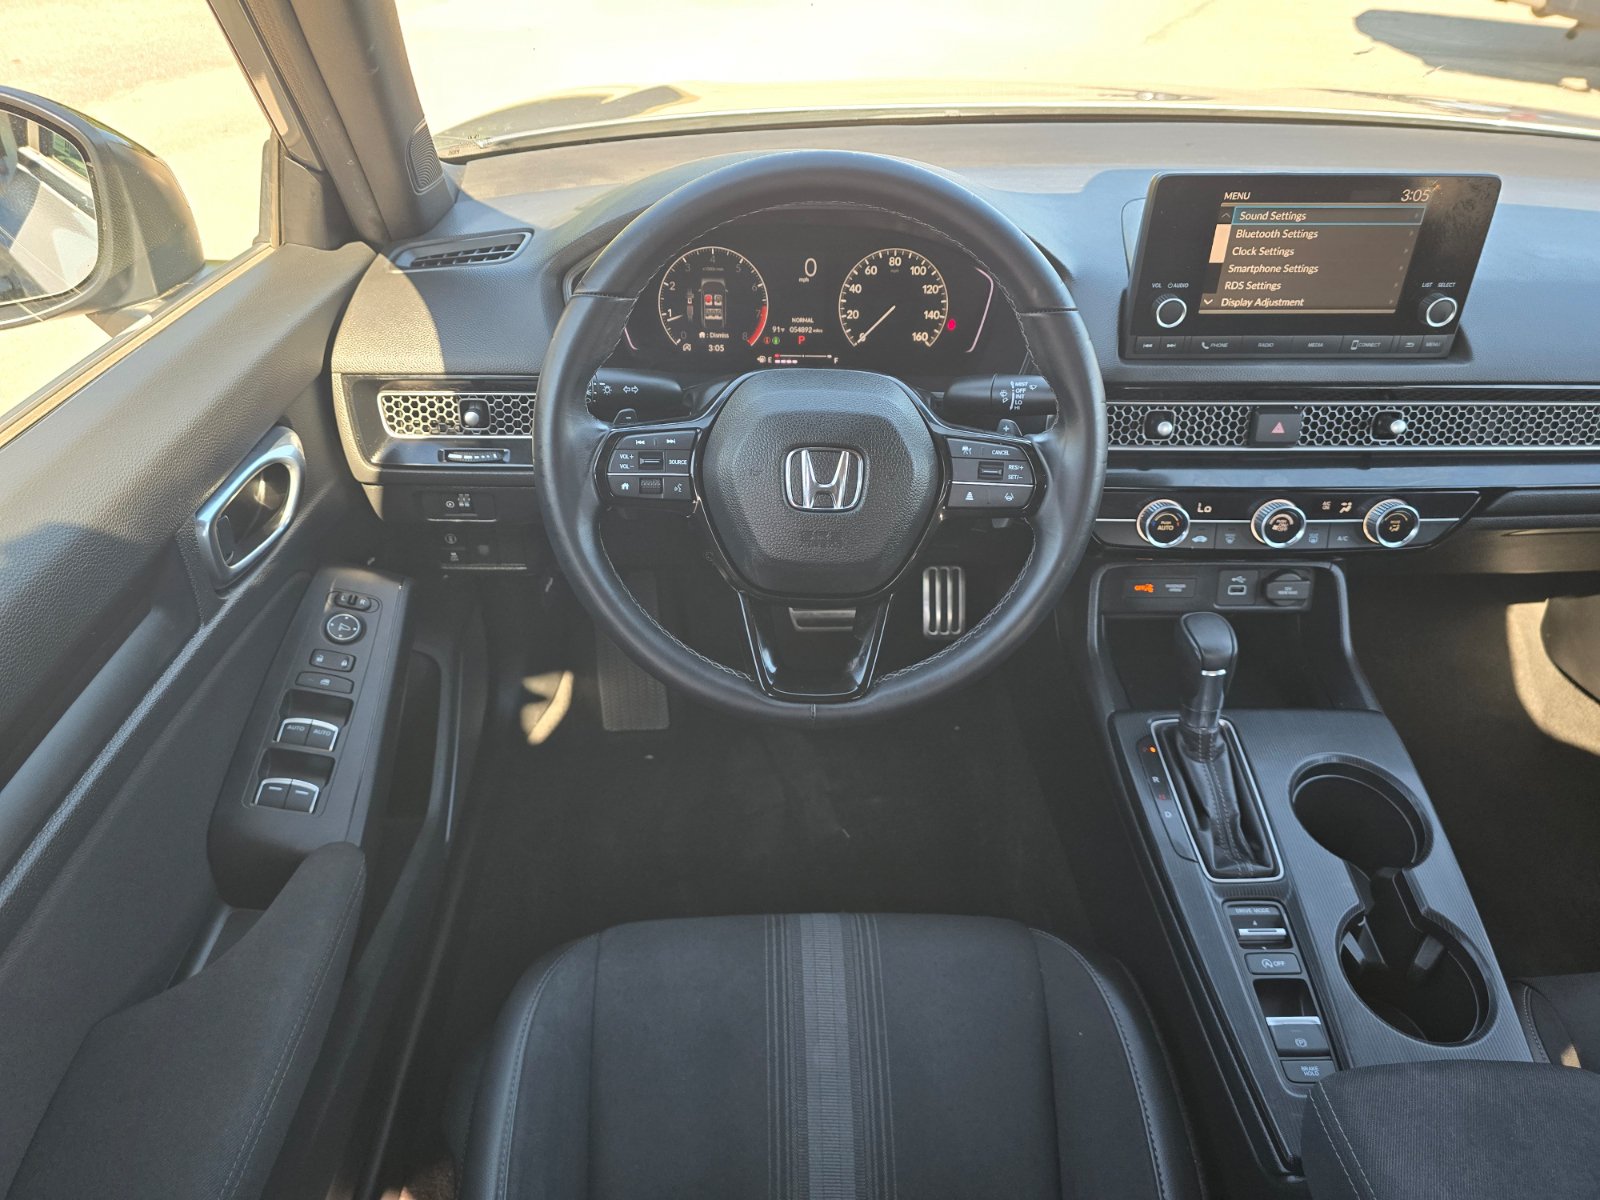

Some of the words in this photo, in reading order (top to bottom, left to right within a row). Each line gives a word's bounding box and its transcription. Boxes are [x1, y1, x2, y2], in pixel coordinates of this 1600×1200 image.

[1224, 192, 1251, 200] MENU
[1401, 189, 1431, 202] 3:05
[1240, 211, 1268, 220] Sound
[1270, 211, 1306, 222] Settings
[1236, 229, 1280, 238] Bluetooth
[1282, 229, 1318, 240] Settings
[1232, 246, 1257, 256] Clock
[1259, 246, 1294, 258] Settings
[888, 257, 902, 266] 80
[804, 258, 818, 276] 0
[864, 266, 878, 275] 60
[910, 266, 926, 276] 100
[1228, 264, 1281, 274] Smartphone
[1283, 264, 1318, 275] Settings
[670, 282, 676, 290] 2
[849, 284, 862, 294] 40
[922, 284, 940, 294] 120
[1224, 282, 1244, 290] RDS
[1246, 282, 1282, 292] Settings
[1221, 298, 1252, 308] Display
[1254, 298, 1304, 308] Adjustment
[668, 309, 672, 317] 1
[846, 310, 860, 319] 20
[924, 310, 940, 320] 140
[798, 336, 806, 344] P
[912, 332, 928, 342] 160
[1198, 502, 1212, 512] Lo
